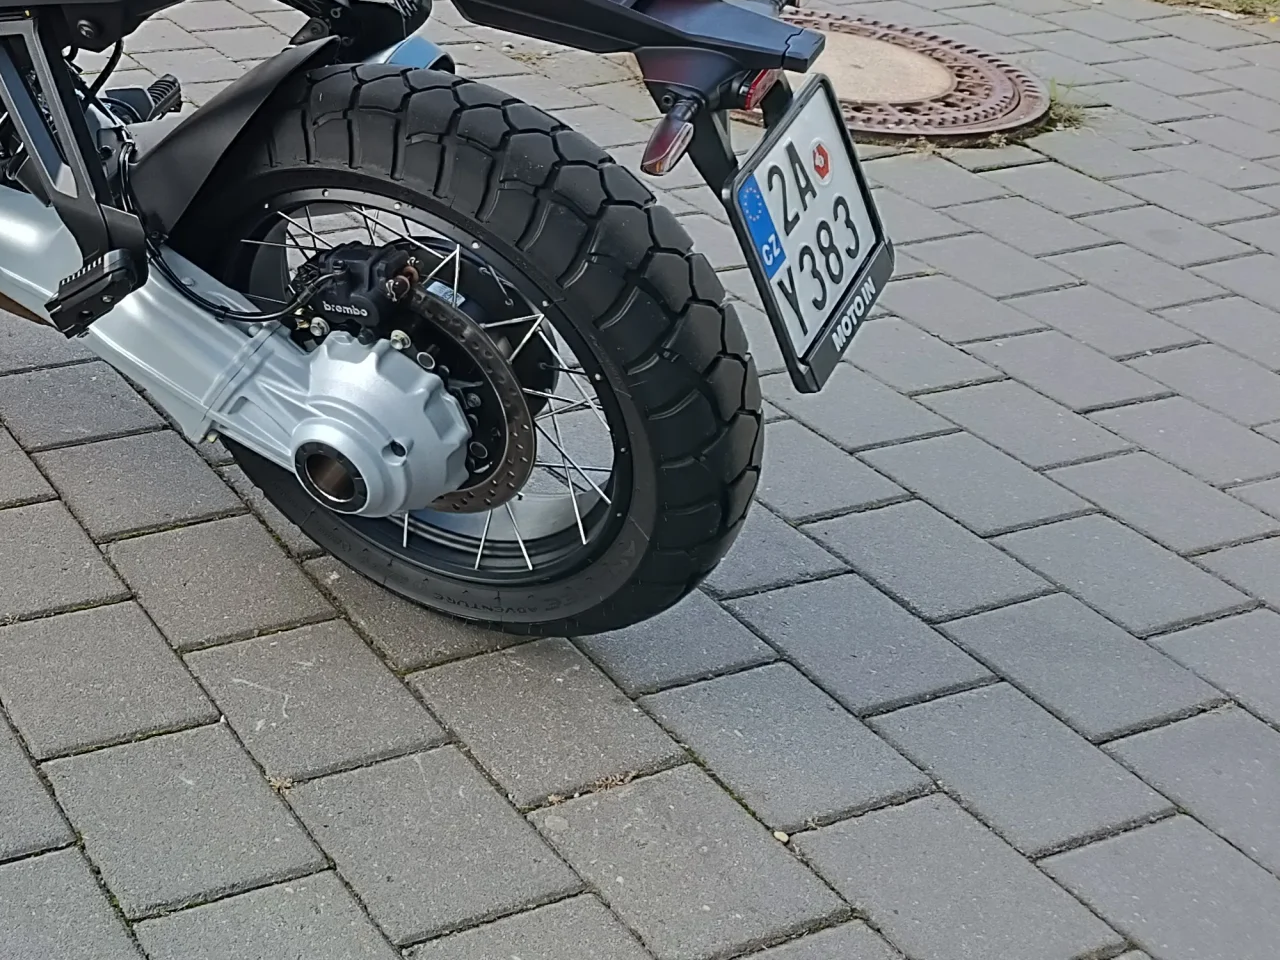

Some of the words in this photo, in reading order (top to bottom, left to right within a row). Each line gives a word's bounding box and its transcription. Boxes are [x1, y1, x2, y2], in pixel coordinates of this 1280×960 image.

[767, 141, 818, 237] 2A
[762, 233, 781, 266] CZ
[777, 195, 861, 337] Y383
[322, 300, 369, 317] brembo
[831, 295, 865, 353] MOTO
[861, 275, 876, 306] IN
